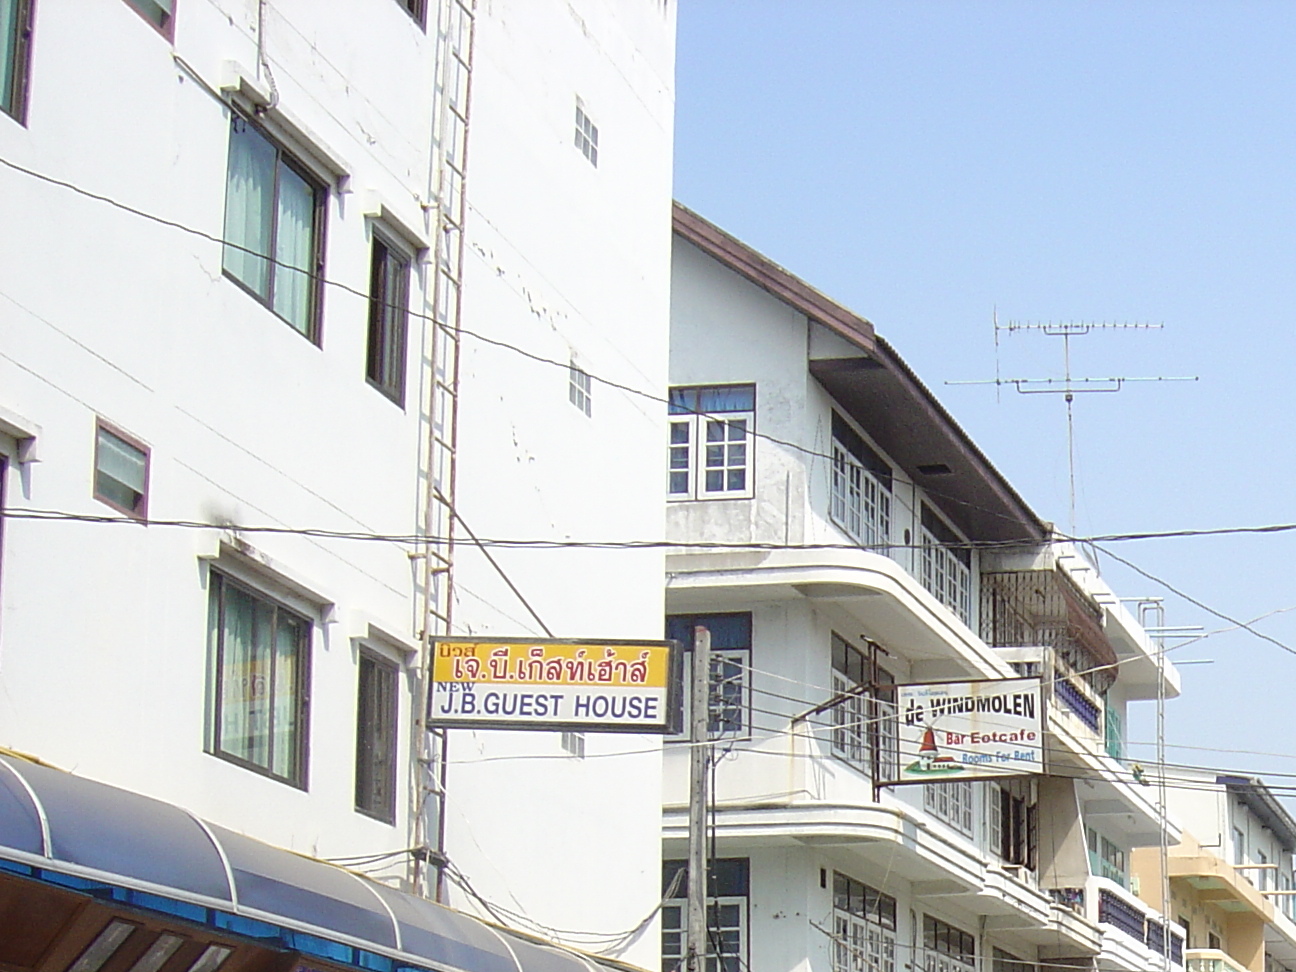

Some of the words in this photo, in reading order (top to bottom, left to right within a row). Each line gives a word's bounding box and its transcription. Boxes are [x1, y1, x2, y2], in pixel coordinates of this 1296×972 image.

[437, 681, 475, 692] NEW
[574, 695, 659, 719] HOUSE
[905, 699, 924, 726] de
[930, 693, 1035, 719] WINDMOLEN
[946, 731, 966, 745] Bar
[962, 753, 993, 763] Rooms
[996, 751, 1010, 762] For
[1014, 750, 1035, 761] Rent
